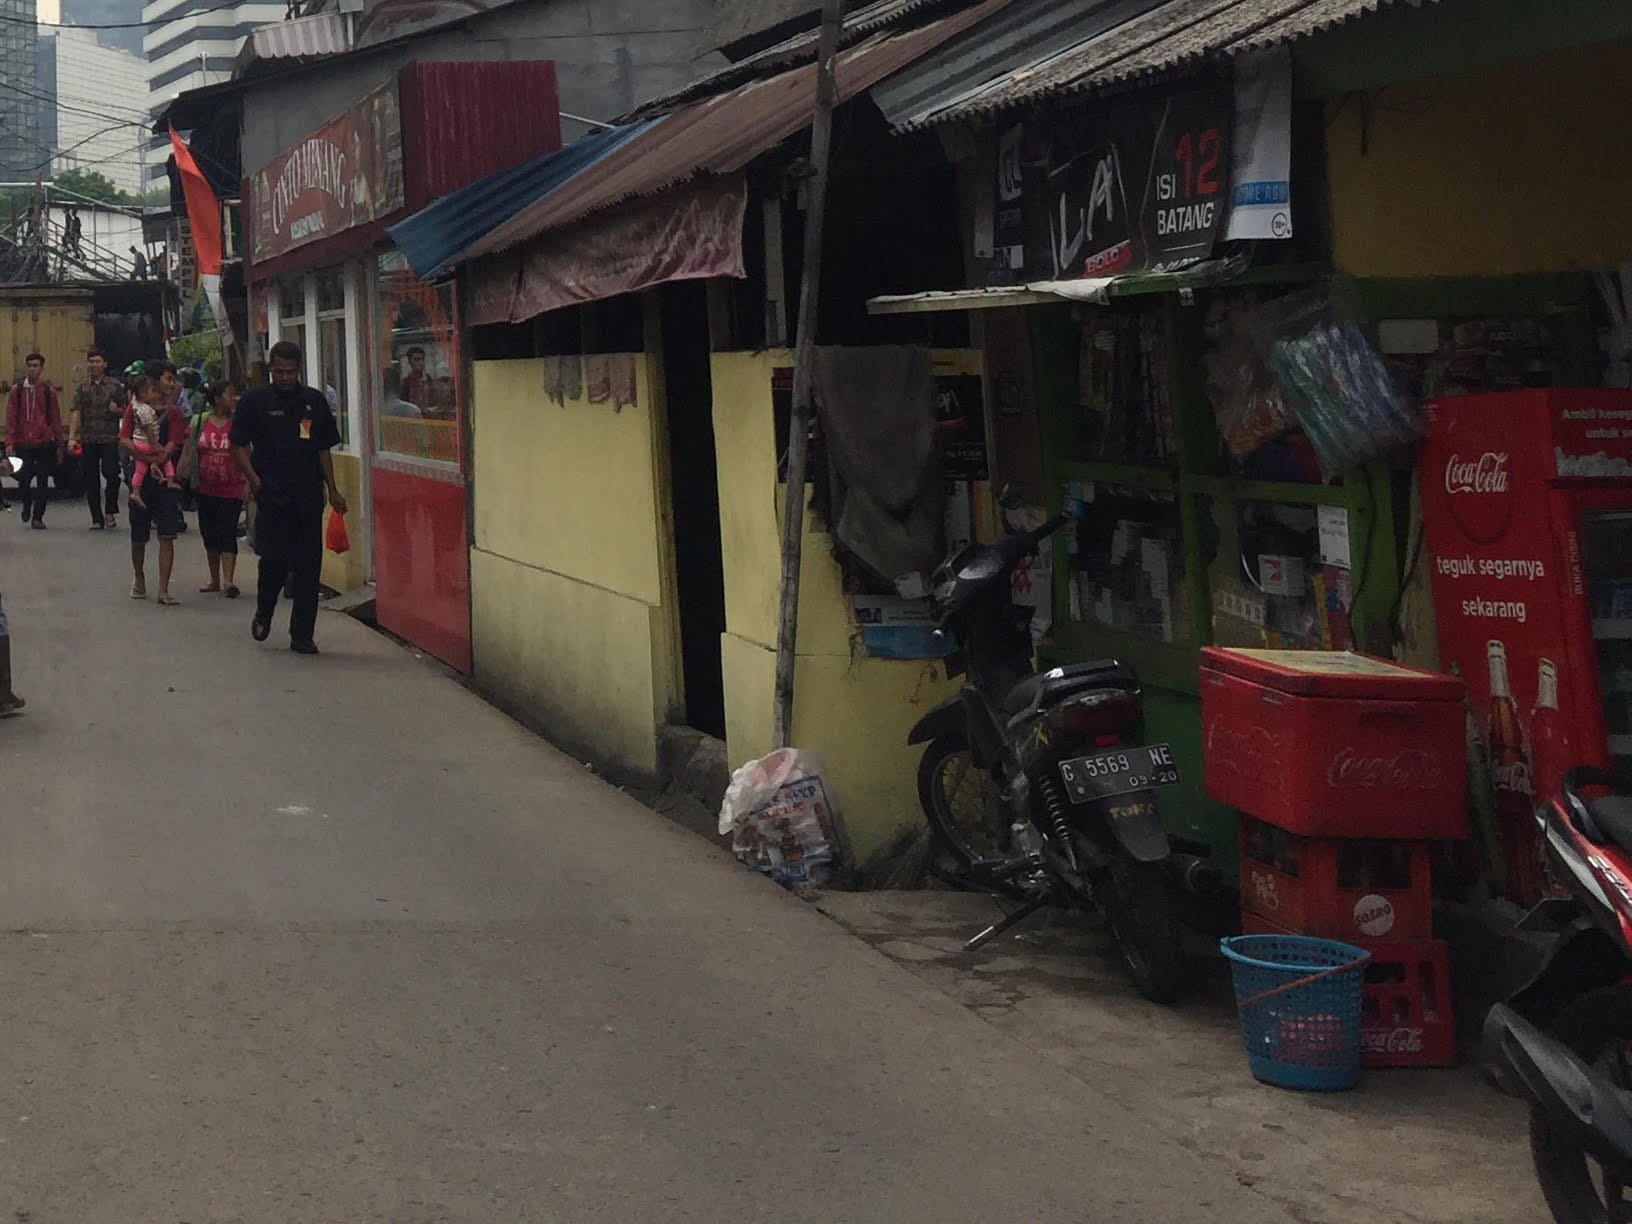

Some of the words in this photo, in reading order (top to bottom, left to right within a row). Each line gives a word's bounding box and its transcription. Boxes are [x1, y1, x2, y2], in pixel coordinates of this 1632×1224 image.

[1156, 173, 1177, 201] ISI
[1175, 128, 1221, 198] 12
[1059, 153, 1114, 271] LA
[1157, 201, 1216, 236] BATANG
[180, 224, 195, 298] STEMPEL
[1437, 555, 1475, 579] teguk
[1479, 559, 1545, 581] segarnya
[1462, 596, 1527, 623] sekarang
[1061, 764, 1075, 782] G
[1086, 753, 1130, 777] 5569
[1148, 746, 1174, 766] NE
